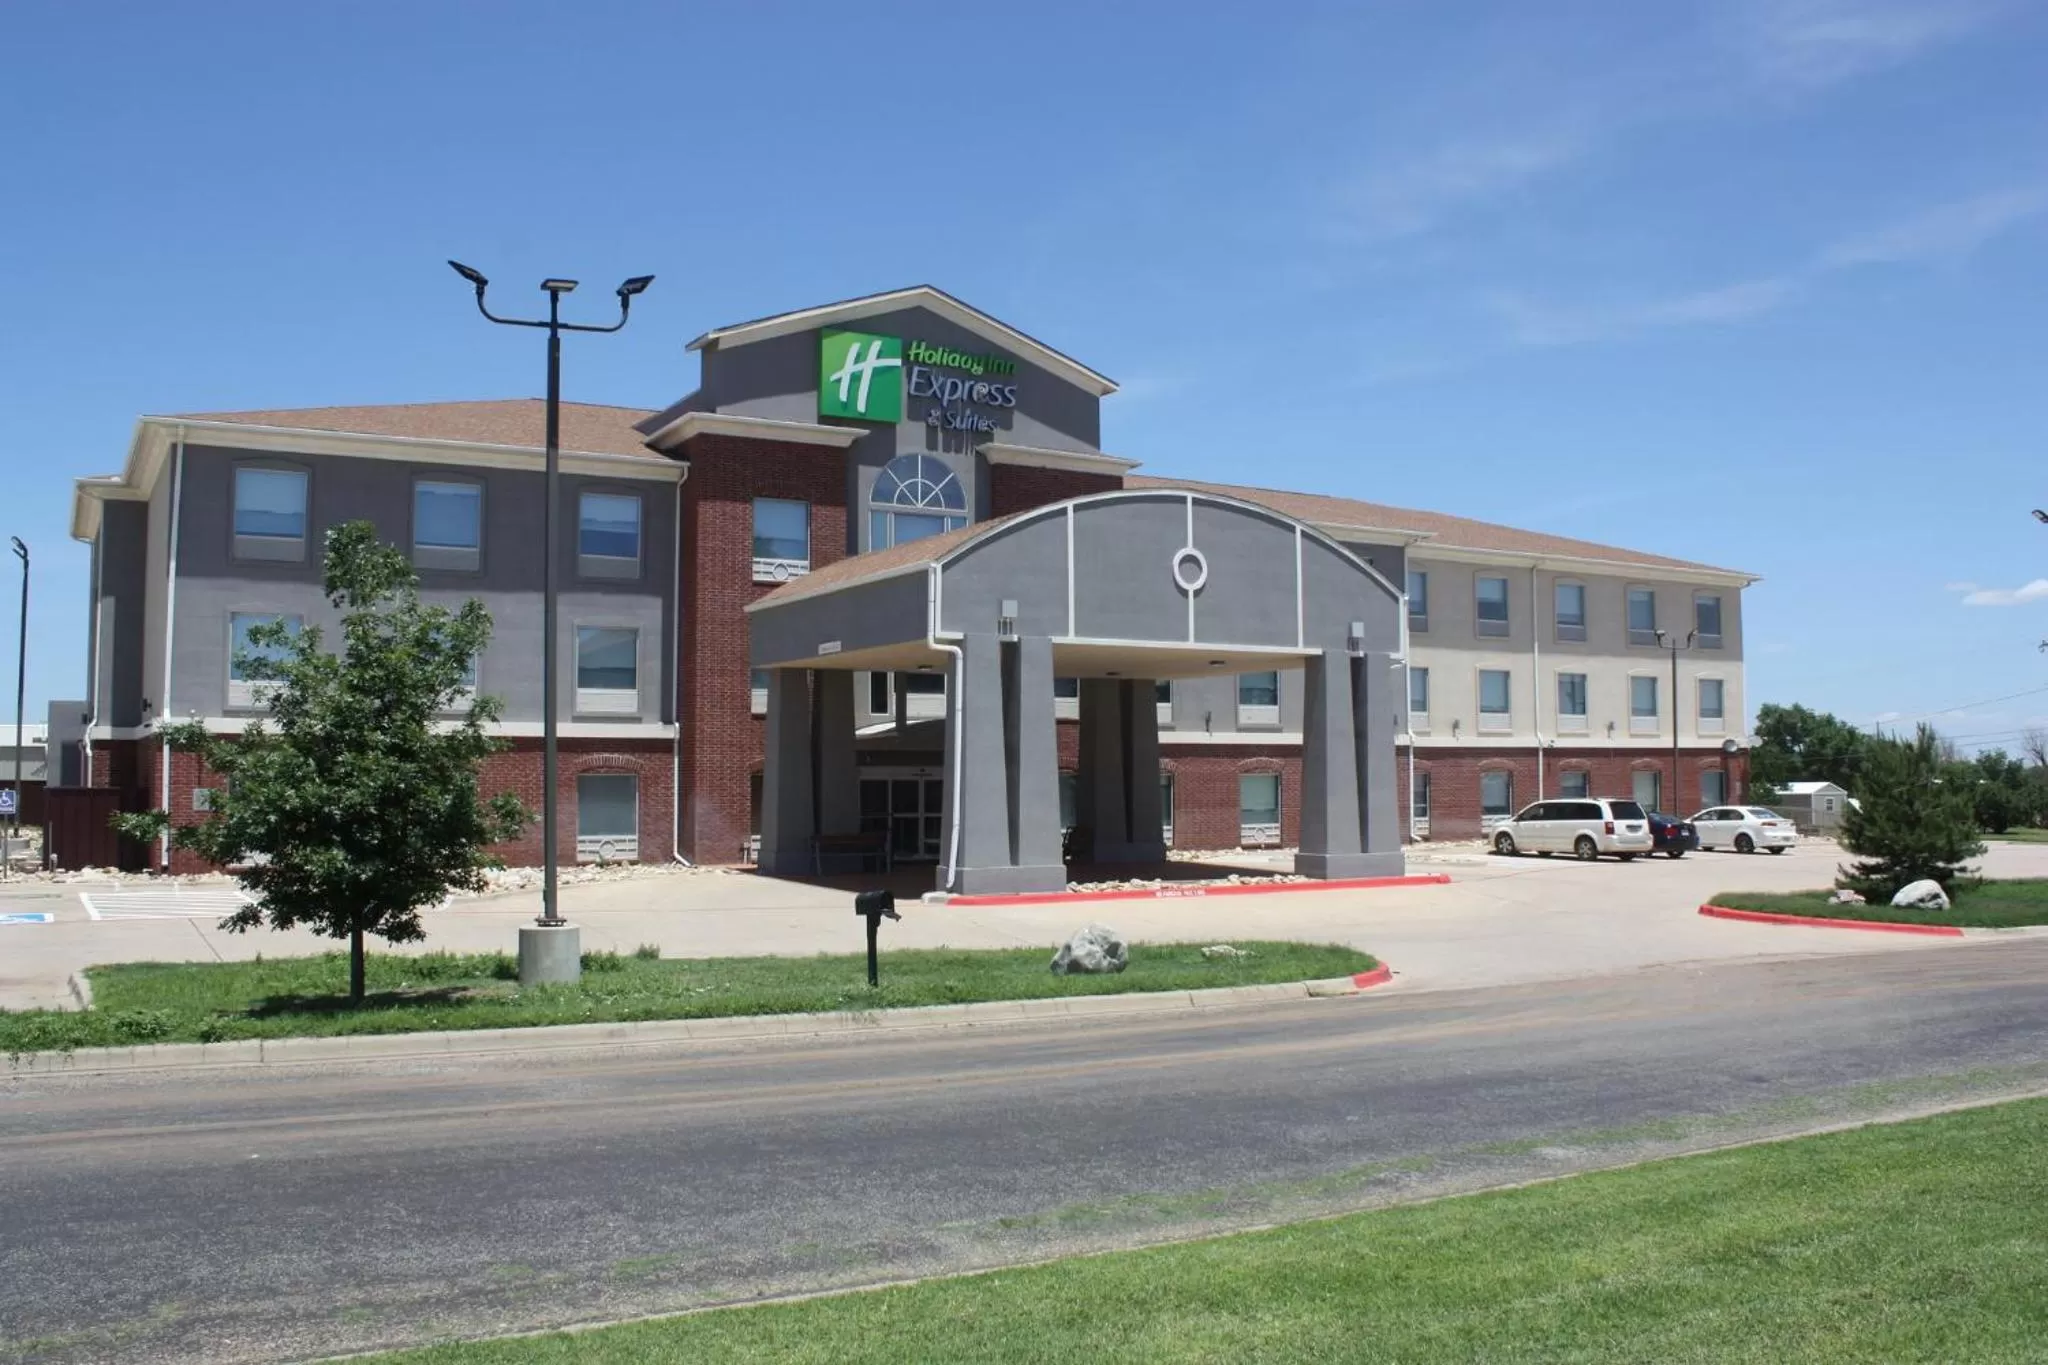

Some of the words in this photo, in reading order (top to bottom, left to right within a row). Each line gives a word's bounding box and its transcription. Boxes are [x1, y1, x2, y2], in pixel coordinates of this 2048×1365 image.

[830, 340, 901, 413] H
[908, 341, 984, 375] Holiday
[988, 352, 1017, 375] Inn
[908, 366, 1017, 408] Express
[927, 408, 940, 427] &
[943, 407, 997, 432] Suites
